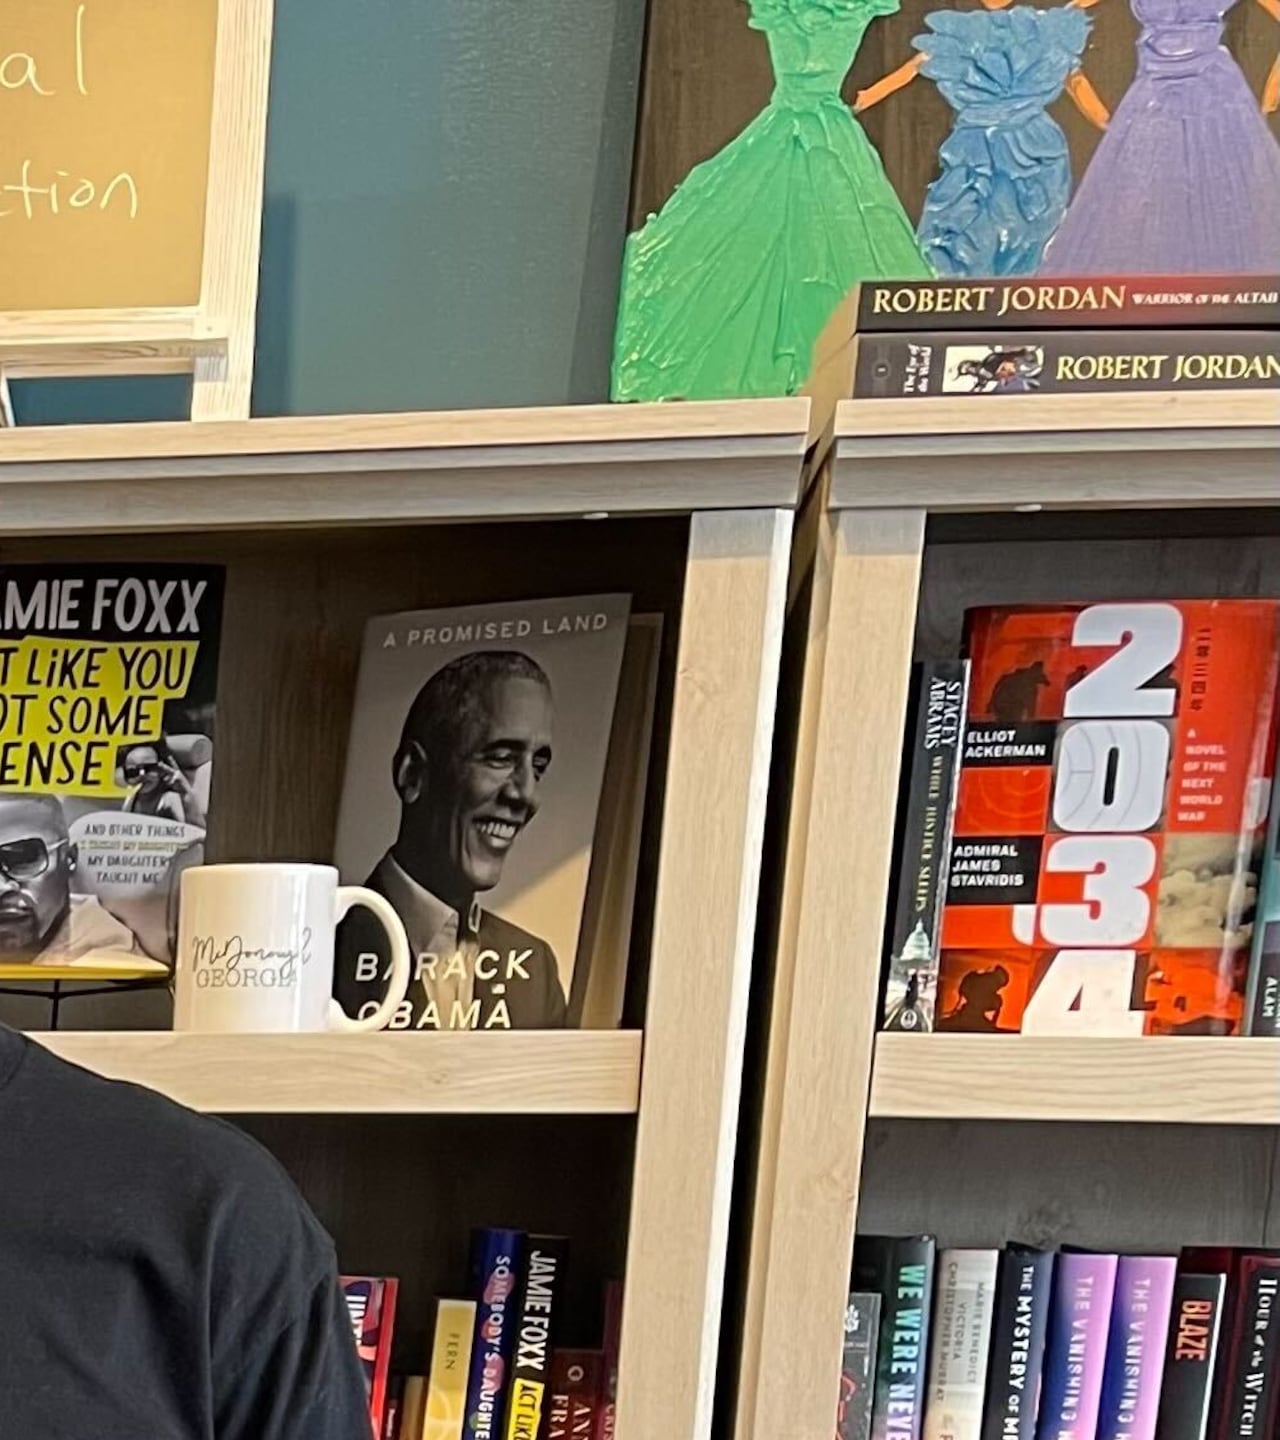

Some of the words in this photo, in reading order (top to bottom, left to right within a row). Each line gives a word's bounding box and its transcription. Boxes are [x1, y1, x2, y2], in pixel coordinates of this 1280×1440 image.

[872, 287, 996, 314] ROBERT
[996, 285, 1126, 316] JORDAN
[1056, 354, 1170, 380] ROBERT
[1171, 353, 1280, 384] JORDAN
[92, 577, 208, 633] FOXX
[383, 632, 398, 648] A
[407, 619, 534, 646] PROMISED
[542, 613, 609, 634] LAND
[118, 645, 188, 690] YOU
[45, 694, 159, 737] SOME
[923, 677, 947, 750] ABRAMS
[940, 680, 963, 748] STACEY
[964, 743, 1047, 758] ACKERMAN
[966, 729, 1018, 745] ELLIOT
[952, 858, 1001, 873] JAMES
[953, 843, 1019, 858] ADMIRAL
[951, 872, 1025, 888] STAVRIDIS
[523, 1250, 557, 1314] JAMIE
[897, 1264, 927, 1299] WE
[1073, 1276, 1094, 1311] THE
[1131, 1278, 1151, 1313] THE
[516, 1315, 551, 1370] FOXX
[891, 1307, 923, 1375] WERE
[1008, 1296, 1033, 1390] MYSTERY
[1174, 1300, 1213, 1361] BLAZE
[445, 1332, 461, 1370] FERN
[1059, 1319, 1089, 1421] VANISHING
[1116, 1321, 1145, 1423] VANISHING
[518, 1383, 539, 1410] ACT
